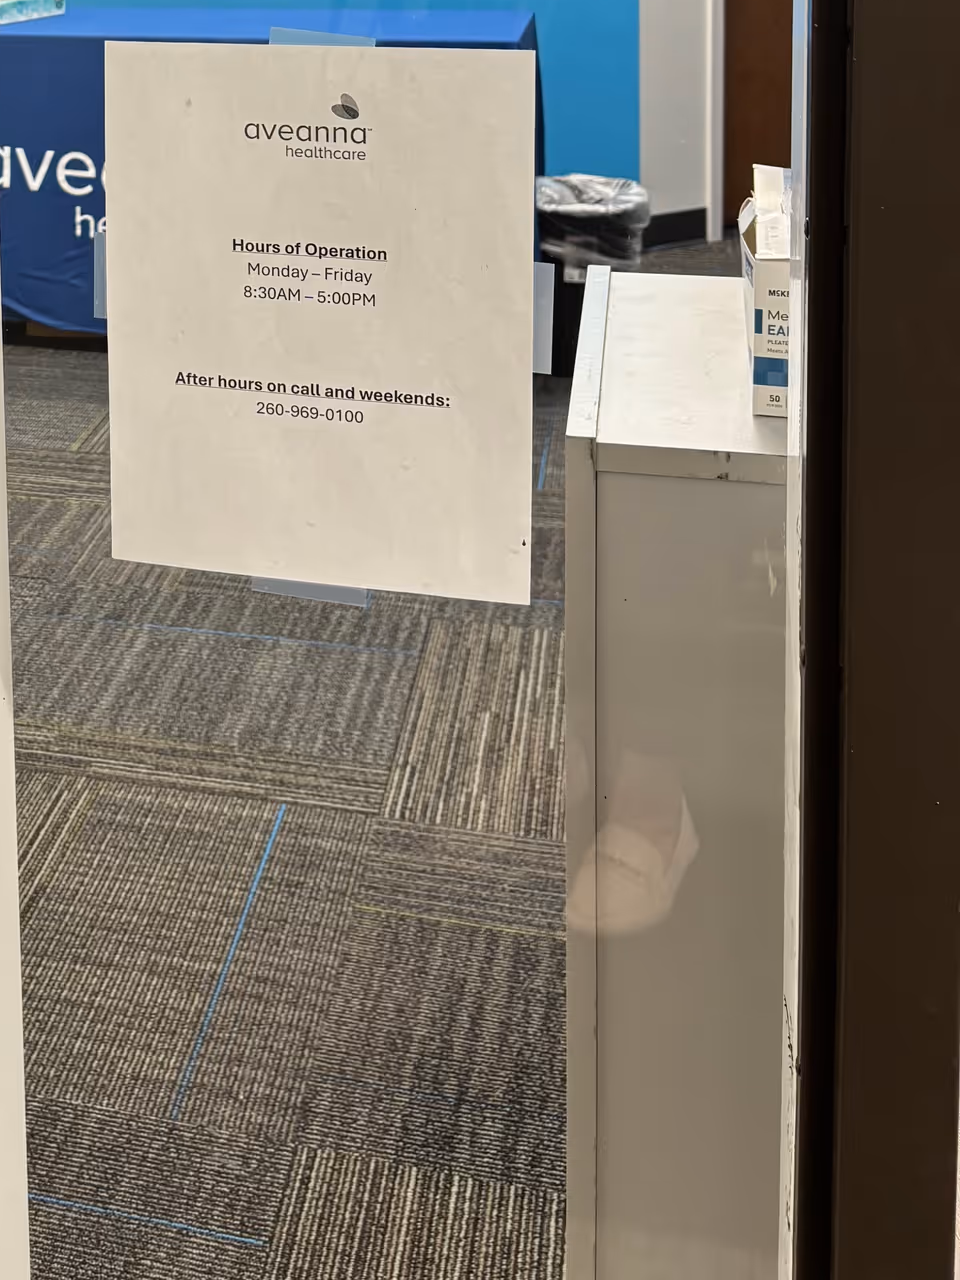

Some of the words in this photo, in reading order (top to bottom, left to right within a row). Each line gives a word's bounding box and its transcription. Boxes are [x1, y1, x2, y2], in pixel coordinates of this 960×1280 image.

[244, 122, 367, 144] aveanna
[285, 145, 366, 160] healthcare
[232, 238, 281, 253] Hours
[285, 242, 301, 255] of
[305, 243, 387, 261] Operation
[247, 262, 309, 281] Monday
[324, 267, 373, 285] Friday
[243, 285, 301, 301] 8:30AM
[317, 290, 376, 307] 5:00PM
[175, 371, 214, 387] After
[218, 375, 263, 391] hours
[267, 381, 287, 394] on
[291, 383, 321, 397] call
[325, 387, 355, 400] and
[359, 389, 451, 407] weekends:
[769, 394, 781, 402] 50
[256, 401, 364, 424] 260-969-0100
